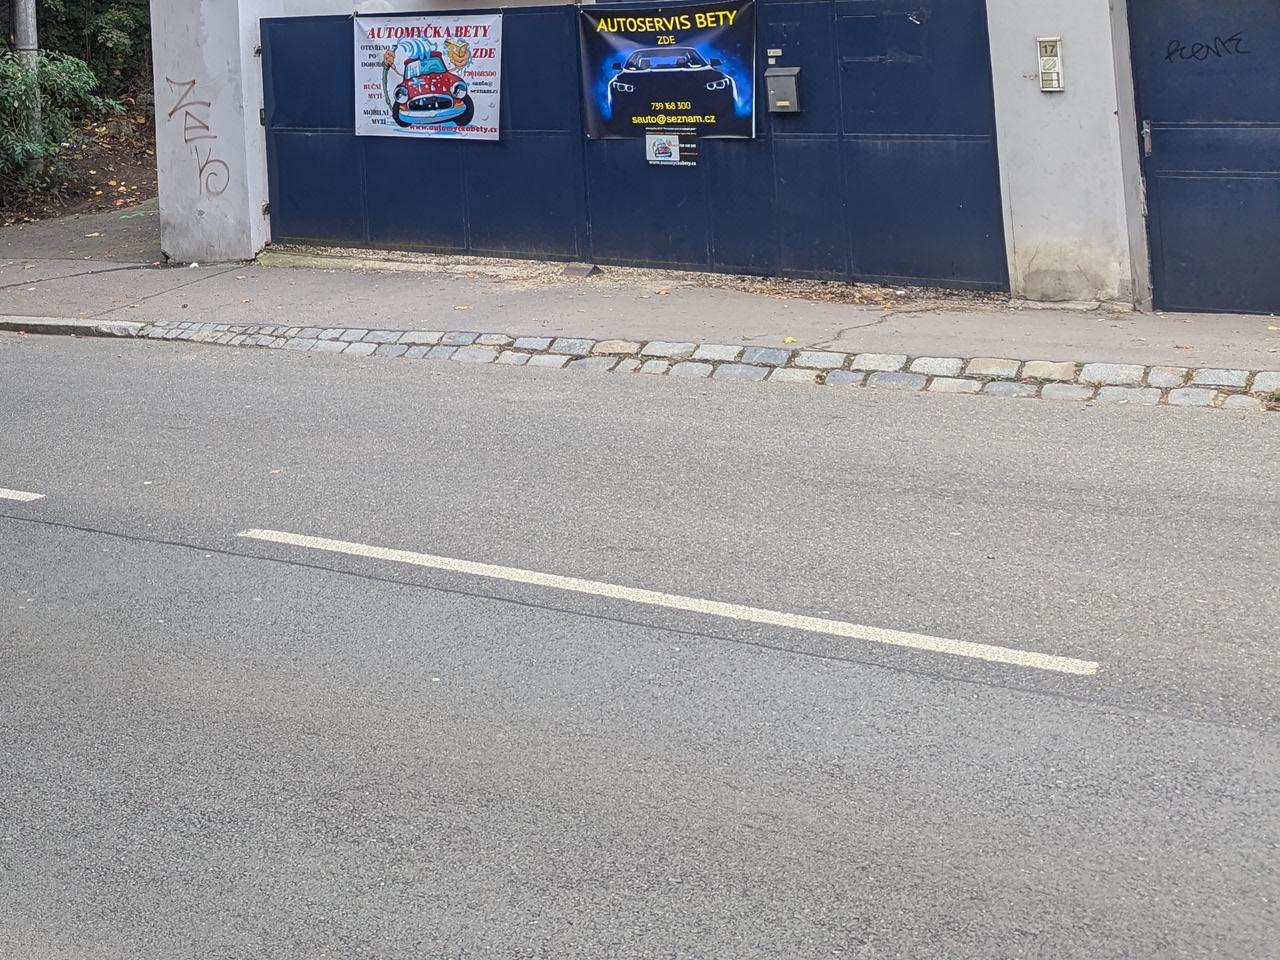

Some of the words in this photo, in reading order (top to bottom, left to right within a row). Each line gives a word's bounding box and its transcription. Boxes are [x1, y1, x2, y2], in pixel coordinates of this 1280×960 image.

[596, 15, 691, 33] AUTOSERVIS
[695, 10, 737, 28] BETY
[367, 24, 451, 39] AUTOMYČKA
[455, 25, 491, 38] BETY
[656, 35, 677, 45] ZDE
[472, 47, 496, 59] ZDE
[1041, 44, 1056, 54] 17
[650, 102, 664, 110] 739
[677, 101, 691, 110] 300
[631, 114, 716, 125] sauto@seznam.cz
